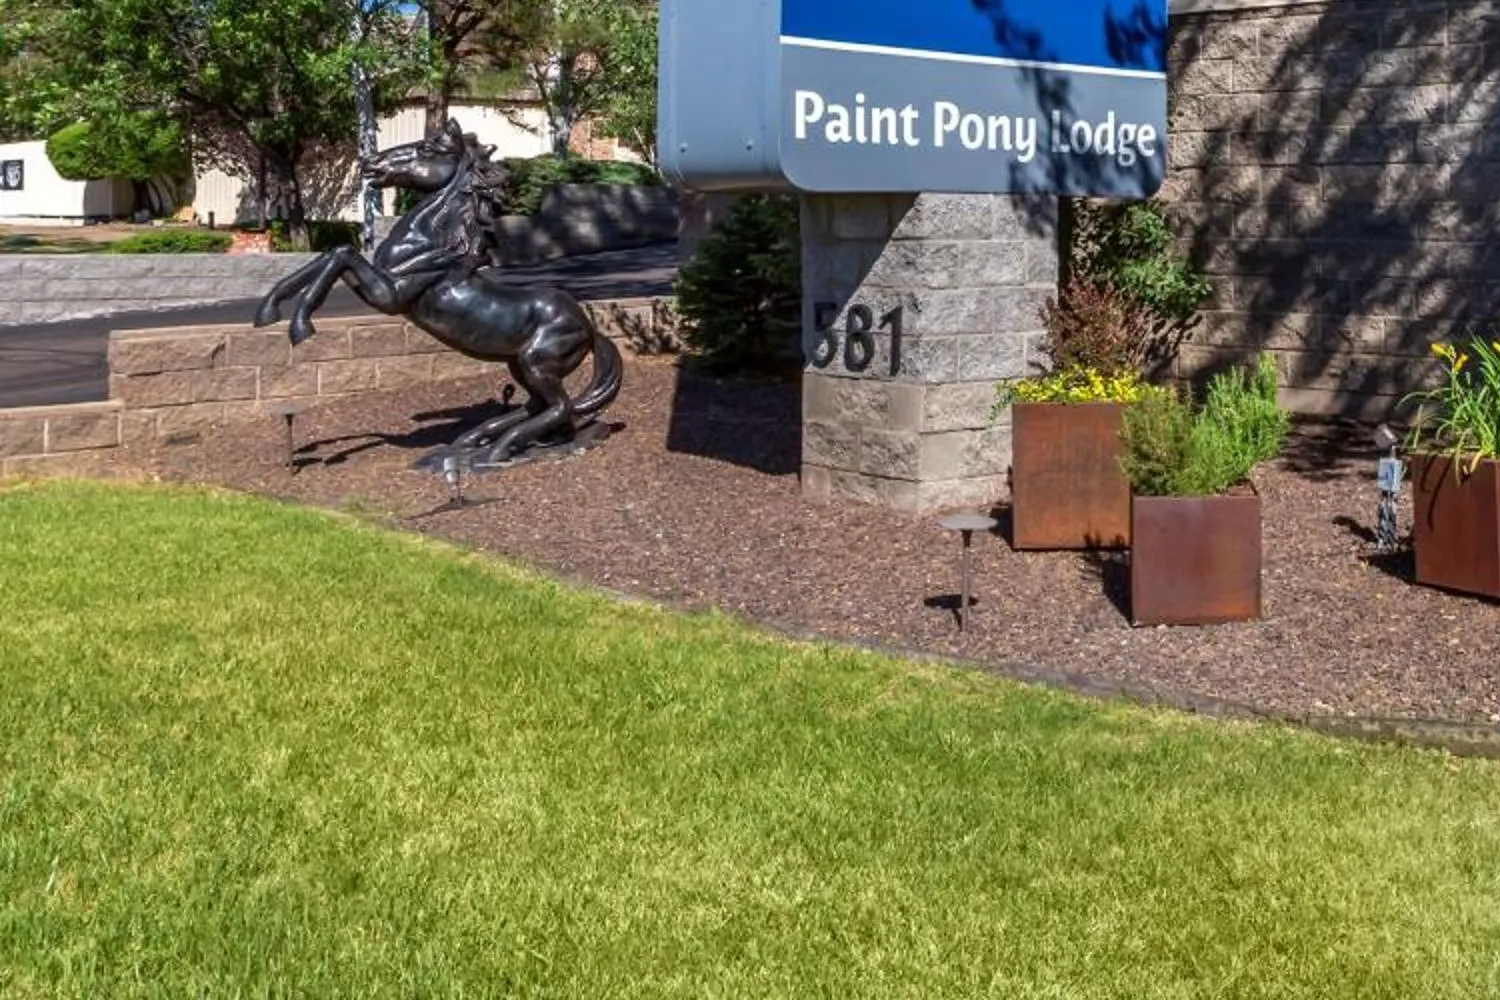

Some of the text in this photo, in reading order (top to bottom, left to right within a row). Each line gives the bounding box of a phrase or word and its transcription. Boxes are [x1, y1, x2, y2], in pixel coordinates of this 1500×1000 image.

[793, 89, 1157, 166] Paint Pony Lodge
[812, 302, 903, 376] 581
